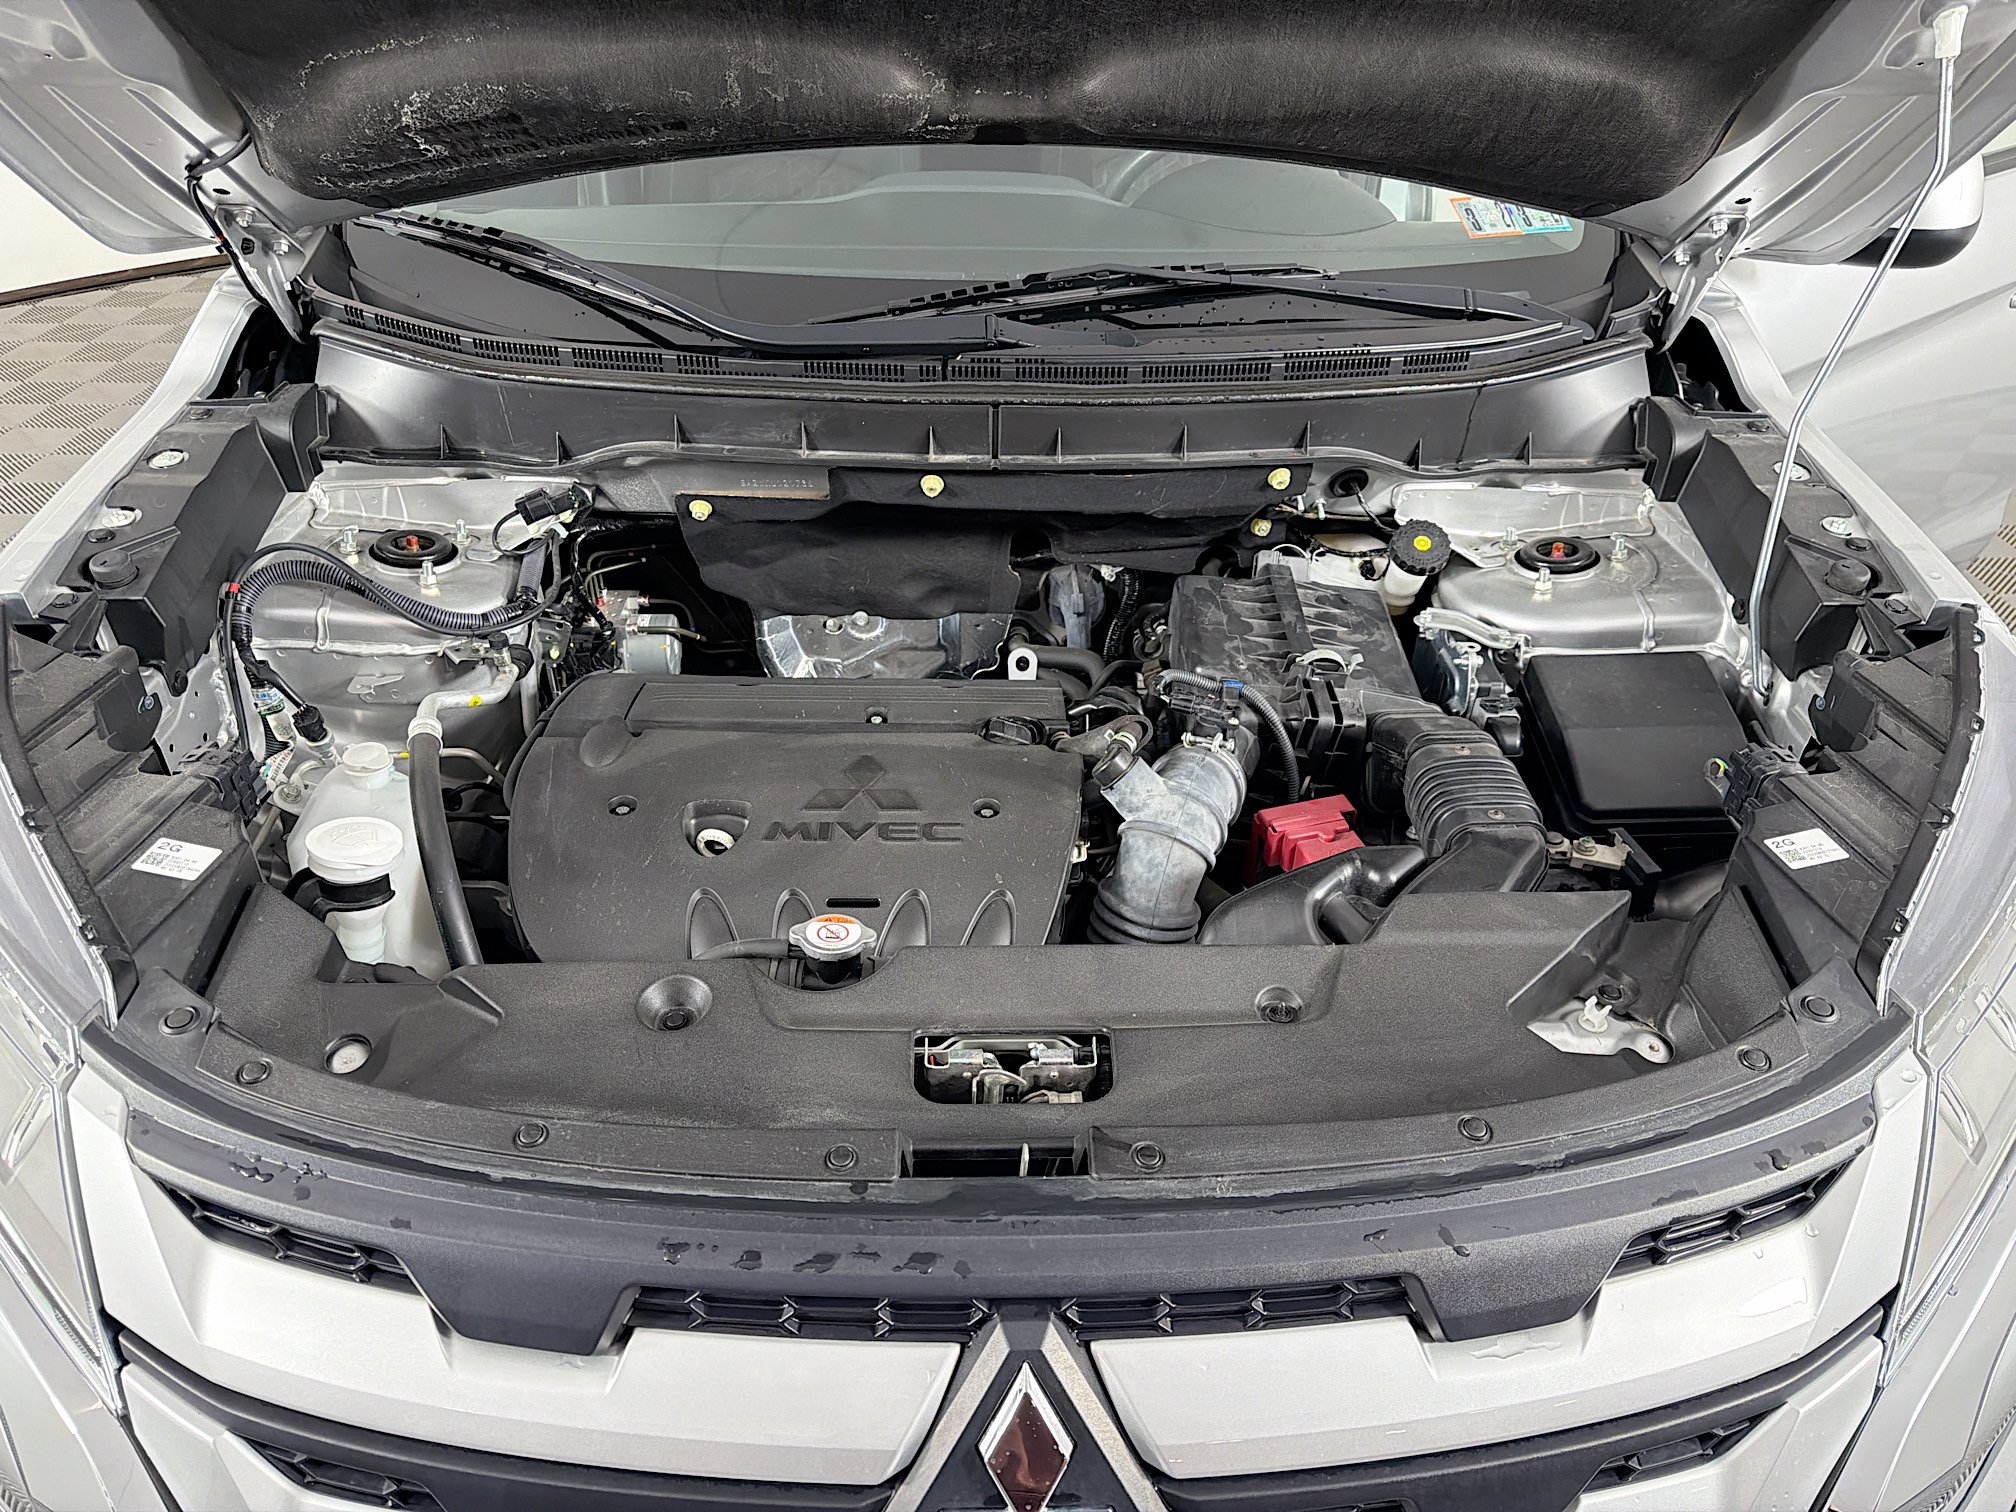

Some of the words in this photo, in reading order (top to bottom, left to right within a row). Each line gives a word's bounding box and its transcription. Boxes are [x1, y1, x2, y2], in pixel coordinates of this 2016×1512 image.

[1464, 207, 1483, 232] 3
[762, 821, 964, 842] MIVEC
[157, 841, 183, 853] 2G
[1772, 838, 1796, 849] 2G
